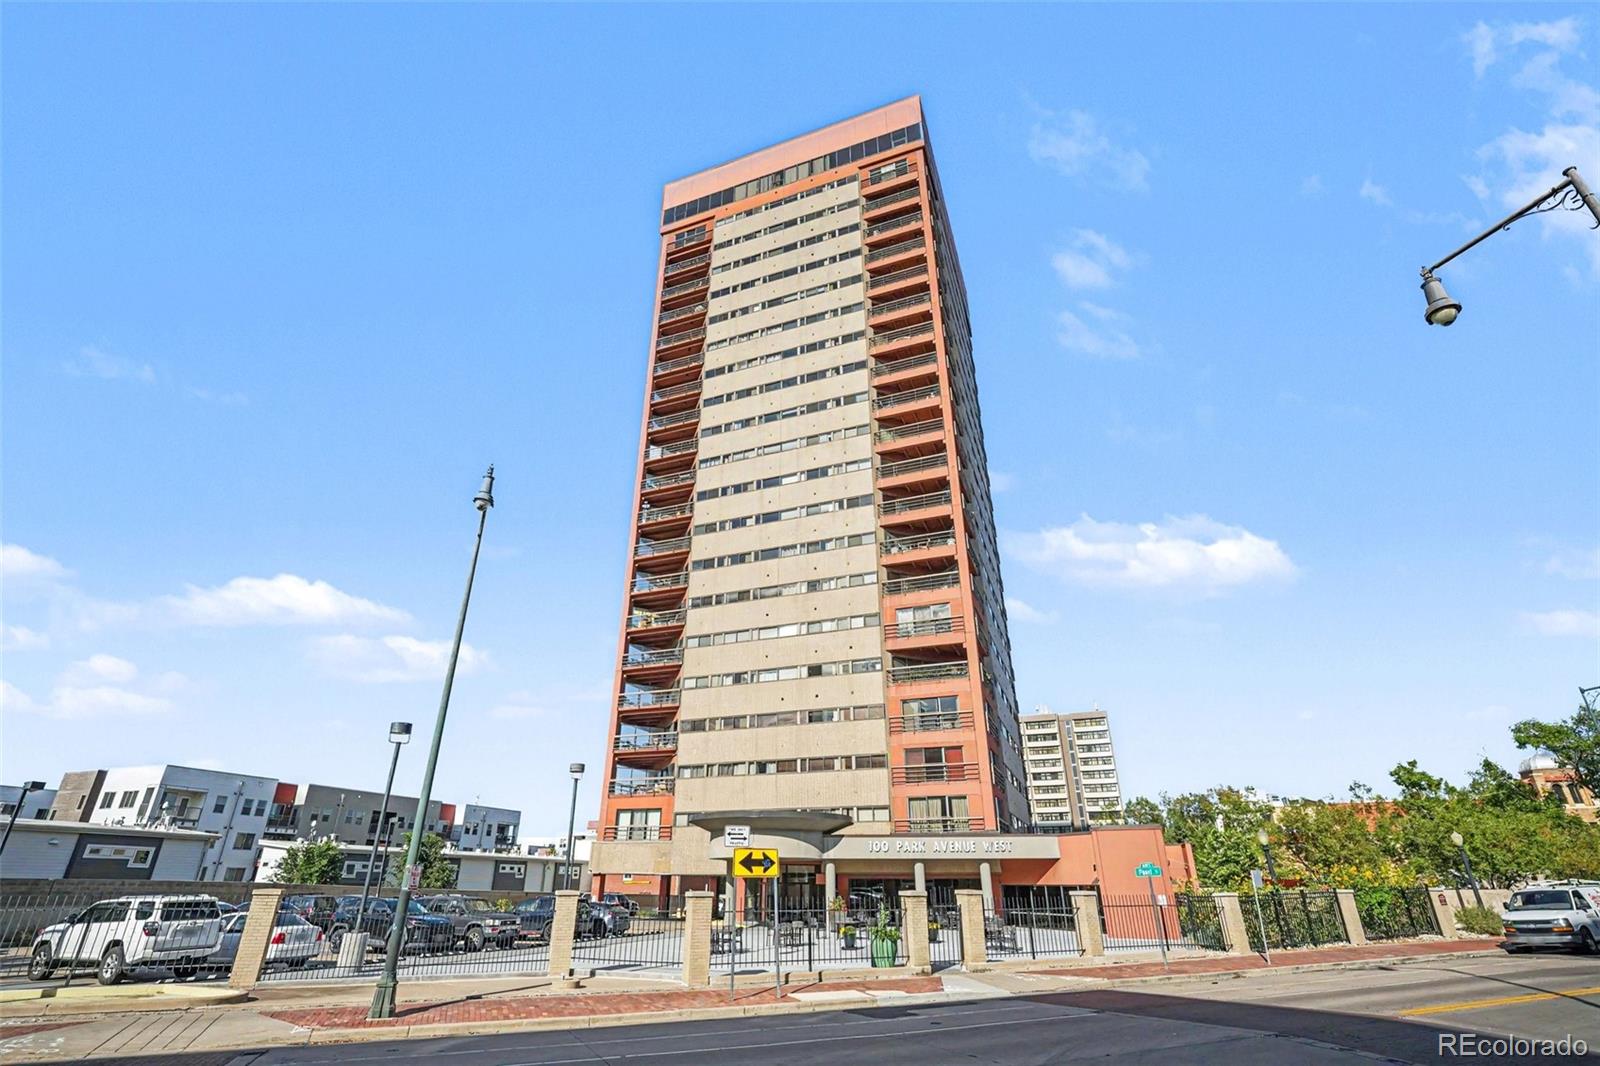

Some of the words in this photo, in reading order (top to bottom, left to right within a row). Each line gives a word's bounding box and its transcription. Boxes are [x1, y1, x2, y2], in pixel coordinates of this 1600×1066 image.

[869, 840, 889, 852] 100
[896, 840, 926, 852] PARK
[933, 840, 976, 852] AVENUE
[983, 840, 1012, 852] WEST
